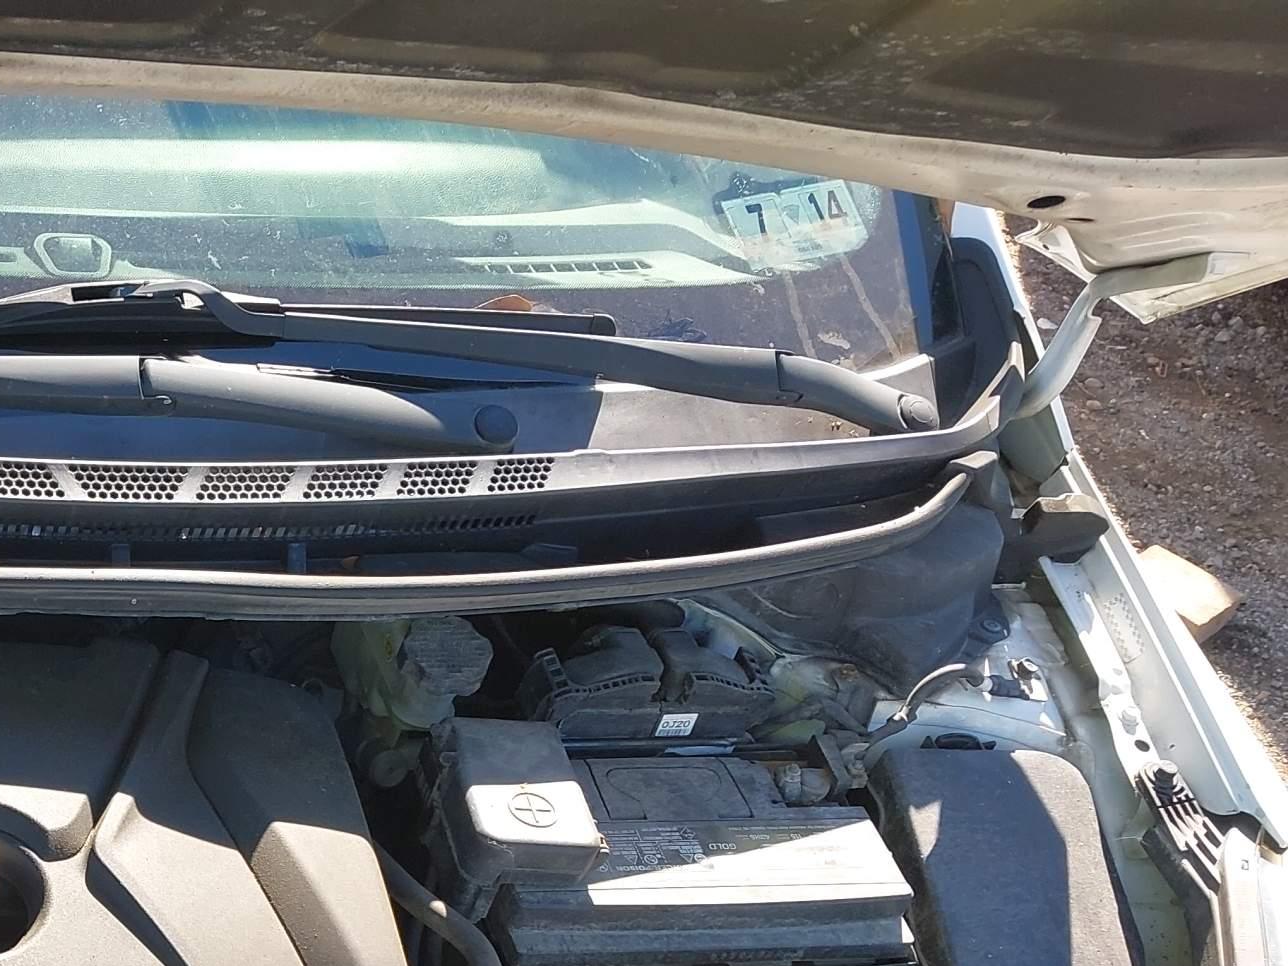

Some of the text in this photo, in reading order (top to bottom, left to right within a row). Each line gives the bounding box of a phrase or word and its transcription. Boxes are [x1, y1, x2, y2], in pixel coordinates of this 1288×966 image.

[745, 203, 767, 235] 7
[808, 190, 848, 221] 14
[708, 843, 737, 851] GOLD
